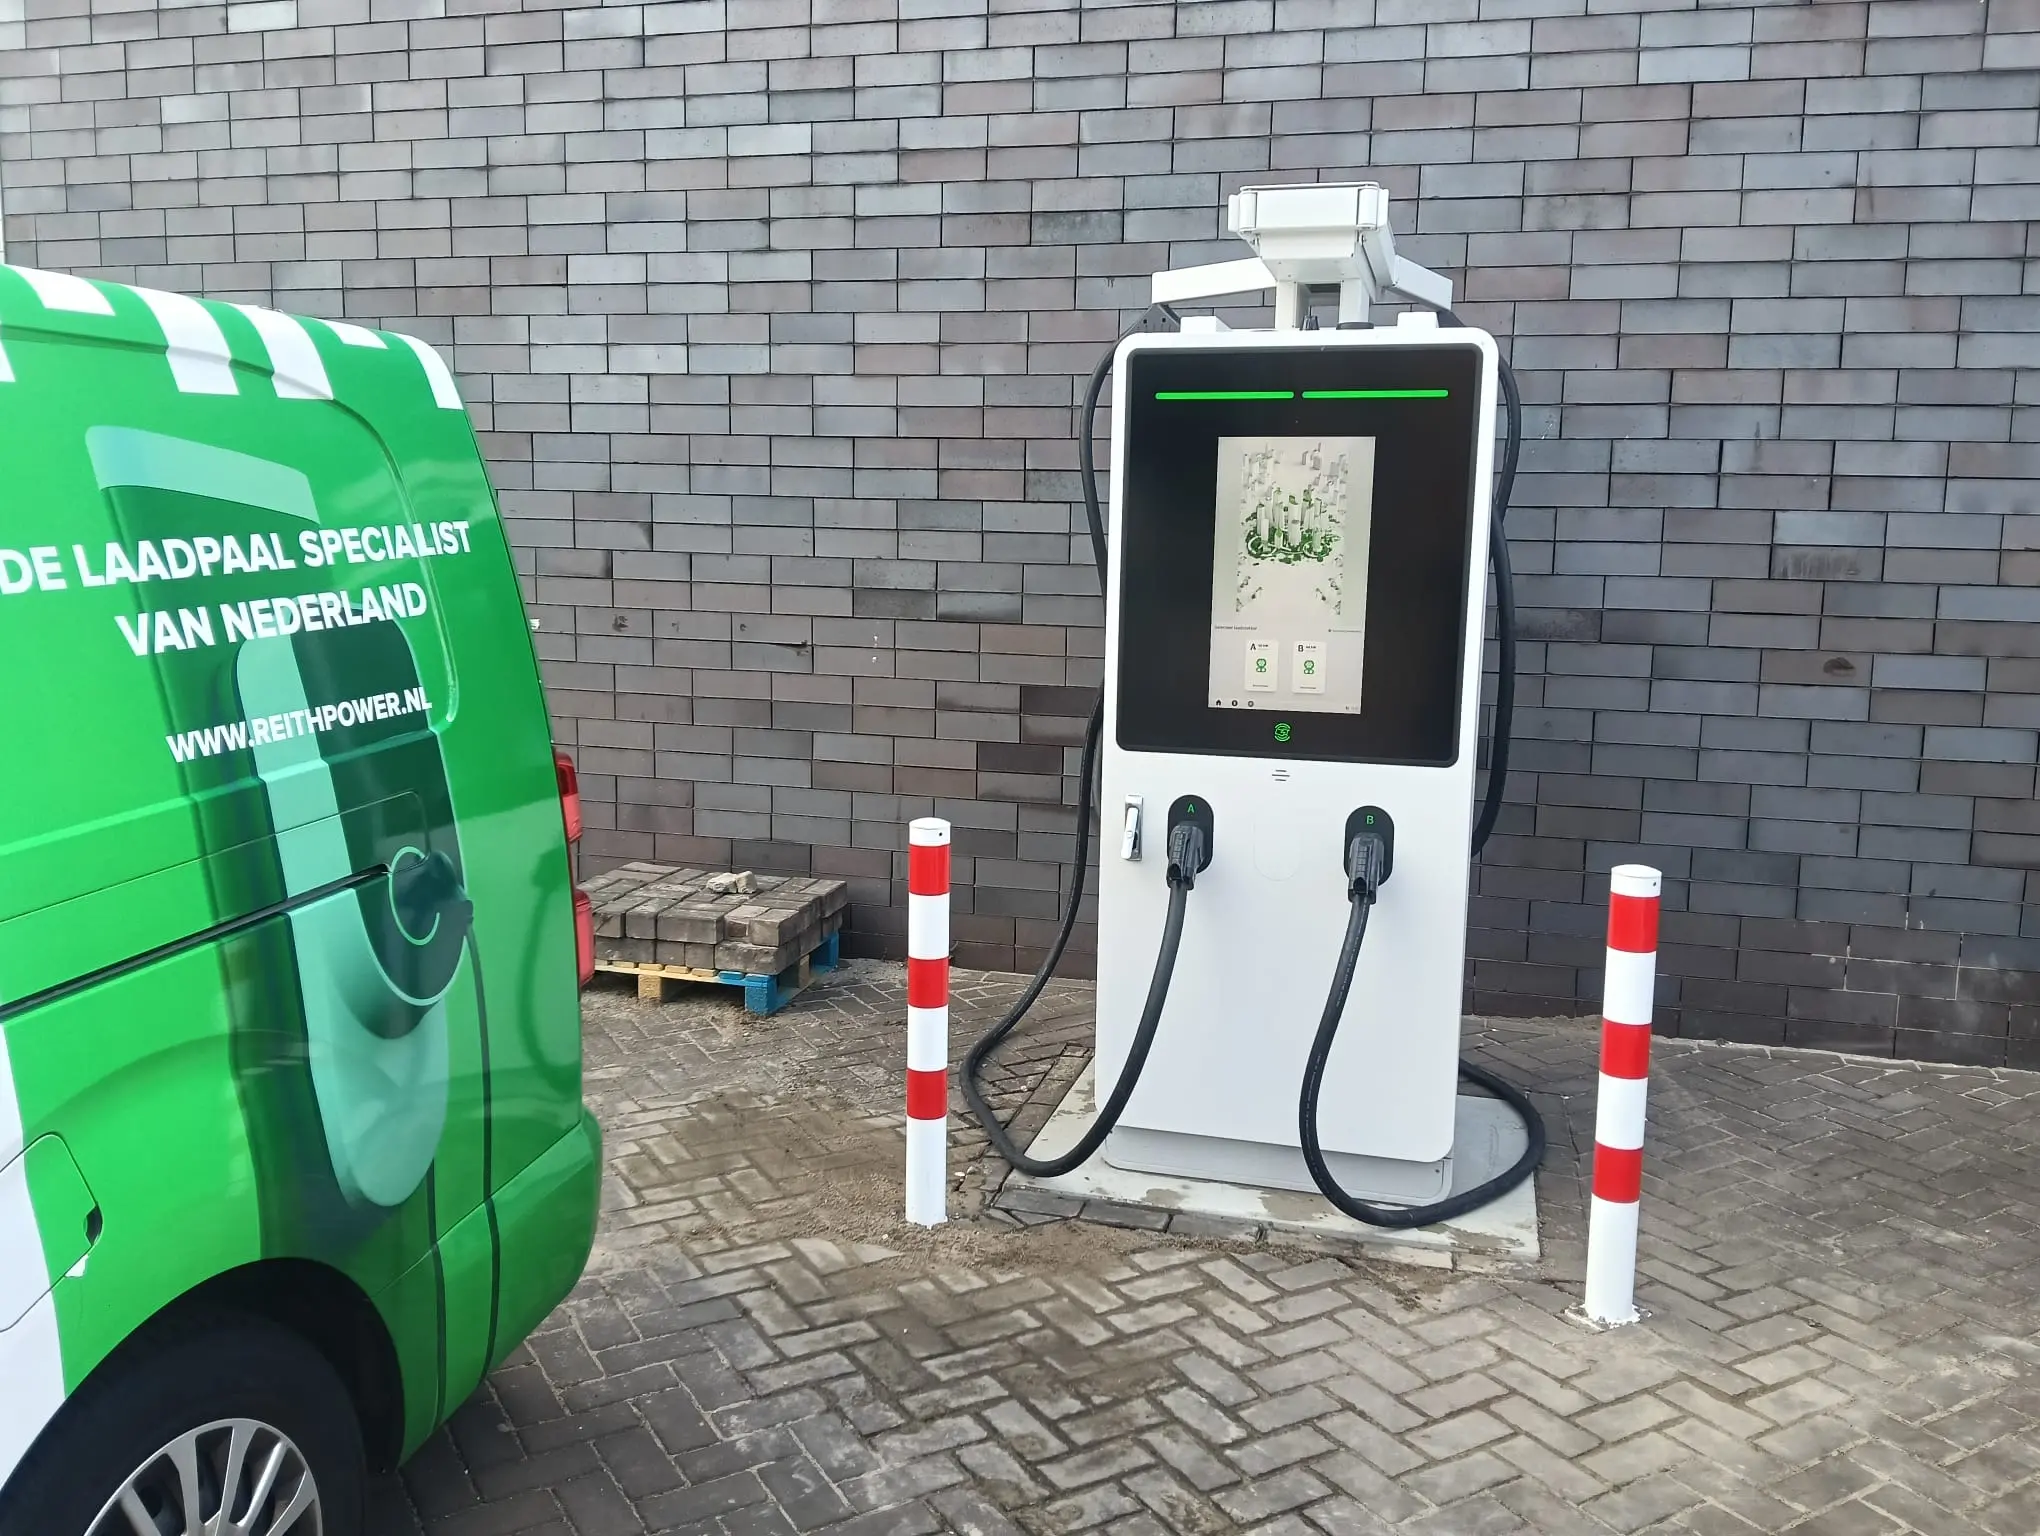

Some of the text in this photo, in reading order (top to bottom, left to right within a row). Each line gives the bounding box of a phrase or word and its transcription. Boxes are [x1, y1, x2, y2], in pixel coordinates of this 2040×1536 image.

[0, 521, 471, 595] DE LAADPAAL SPECIALIST
[115, 583, 427, 656] VAN NEDERLAND
[166, 687, 432, 763] WWW.REITHPOWER.NL
[1187, 803, 1195, 814] A
[1366, 814, 1375, 825] B
